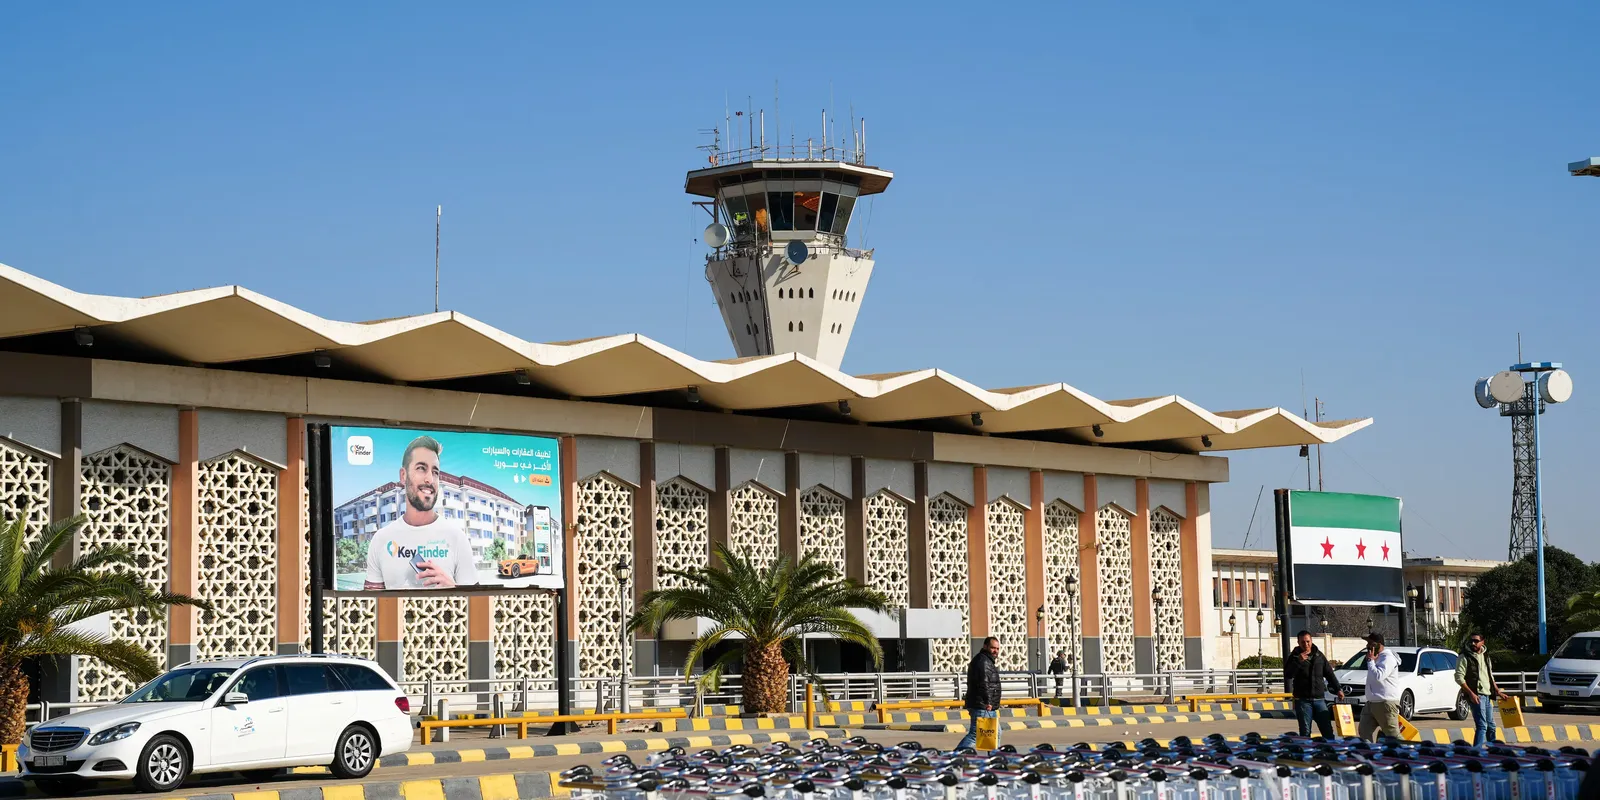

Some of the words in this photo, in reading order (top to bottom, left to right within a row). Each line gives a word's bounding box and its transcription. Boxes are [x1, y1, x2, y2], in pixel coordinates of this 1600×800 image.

[482, 446, 510, 456] والسيارات
[511, 448, 534, 457] العقارات
[535, 449, 551, 459] تطبيق
[520, 461, 532, 470] في
